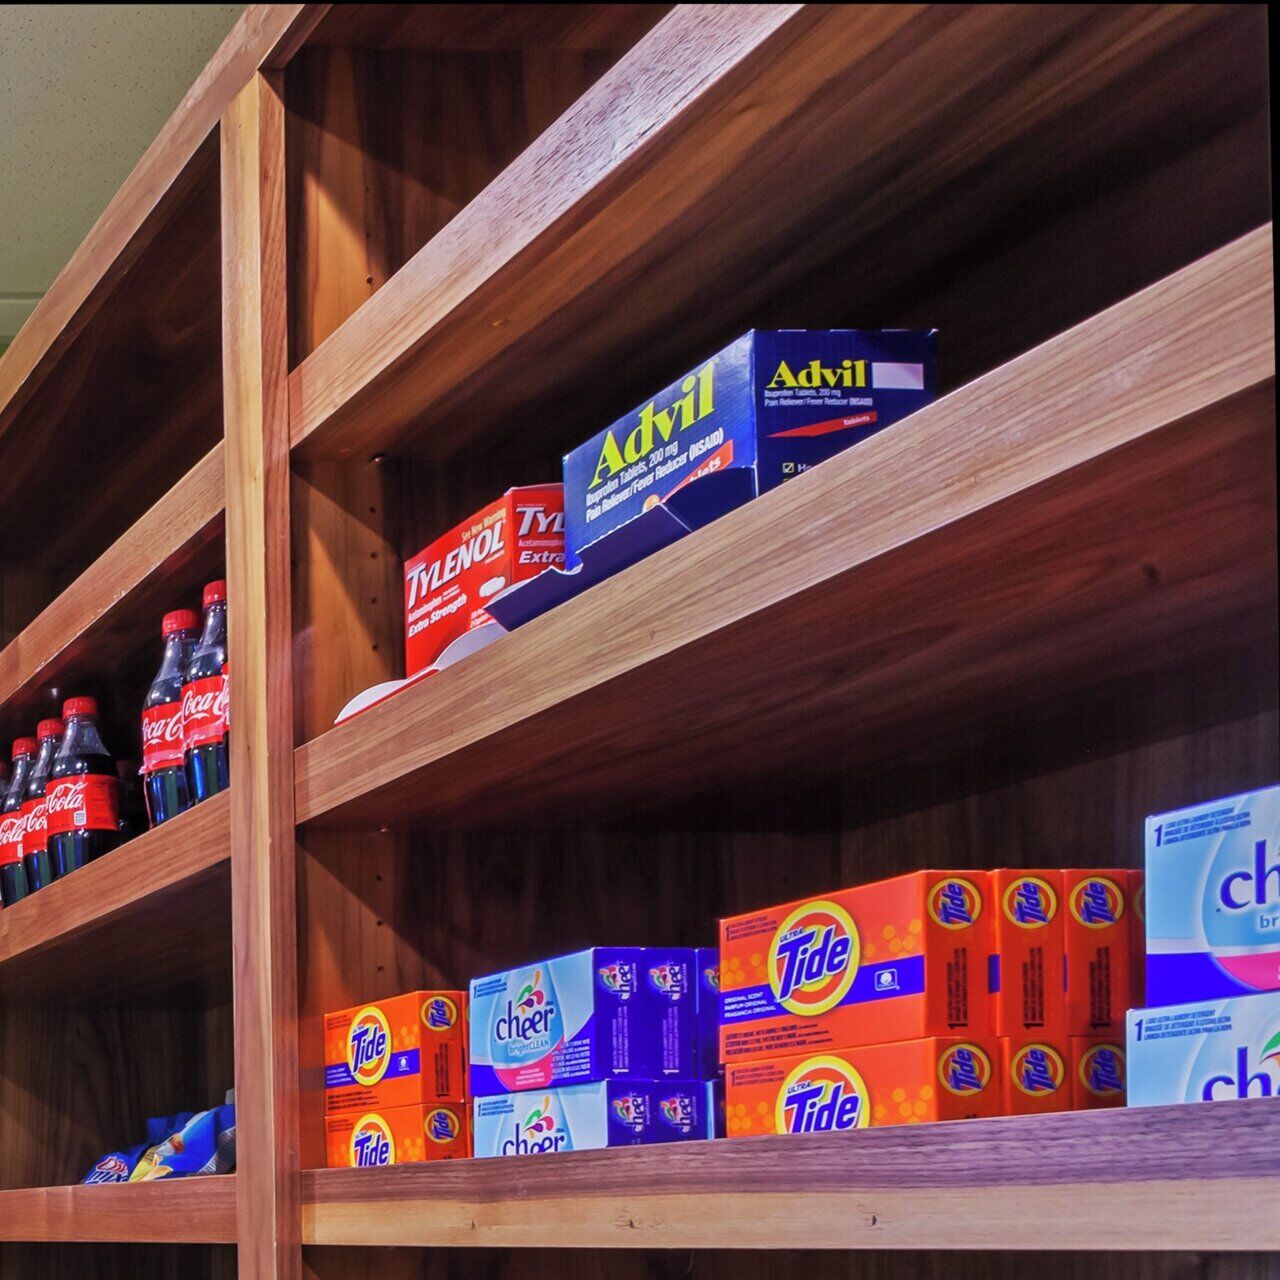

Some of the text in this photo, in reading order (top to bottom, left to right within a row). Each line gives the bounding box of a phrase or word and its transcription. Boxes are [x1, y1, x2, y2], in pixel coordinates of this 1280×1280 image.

[766, 359, 866, 388] Advil
[588, 360, 715, 489] Advil
[585, 475, 619, 507] Ibuprofen
[648, 449, 664, 468] 200
[664, 441, 679, 458] mg
[585, 503, 602, 523] Pain
[655, 452, 689, 481] Reducer
[689, 427, 724, 462] (NSAID)
[407, 520, 505, 609] TYLENOL
[519, 550, 565, 564] Extra
[408, 616, 430, 638] Extra
[430, 594, 468, 622] Strength
[1154, 823, 1163, 848] 1
[938, 880, 974, 924] Tide
[1014, 880, 1050, 924] Tide
[1081, 880, 1117, 924] Tide
[779, 926, 805, 943] ULTRA
[775, 924, 851, 1004] Tide
[496, 999, 555, 1041] cheer
[724, 993, 748, 1004] ORIGINAL
[351, 1024, 387, 1076] Tide
[784, 1081, 860, 1134] Tide
[787, 1079, 812, 1094] ULTRA
